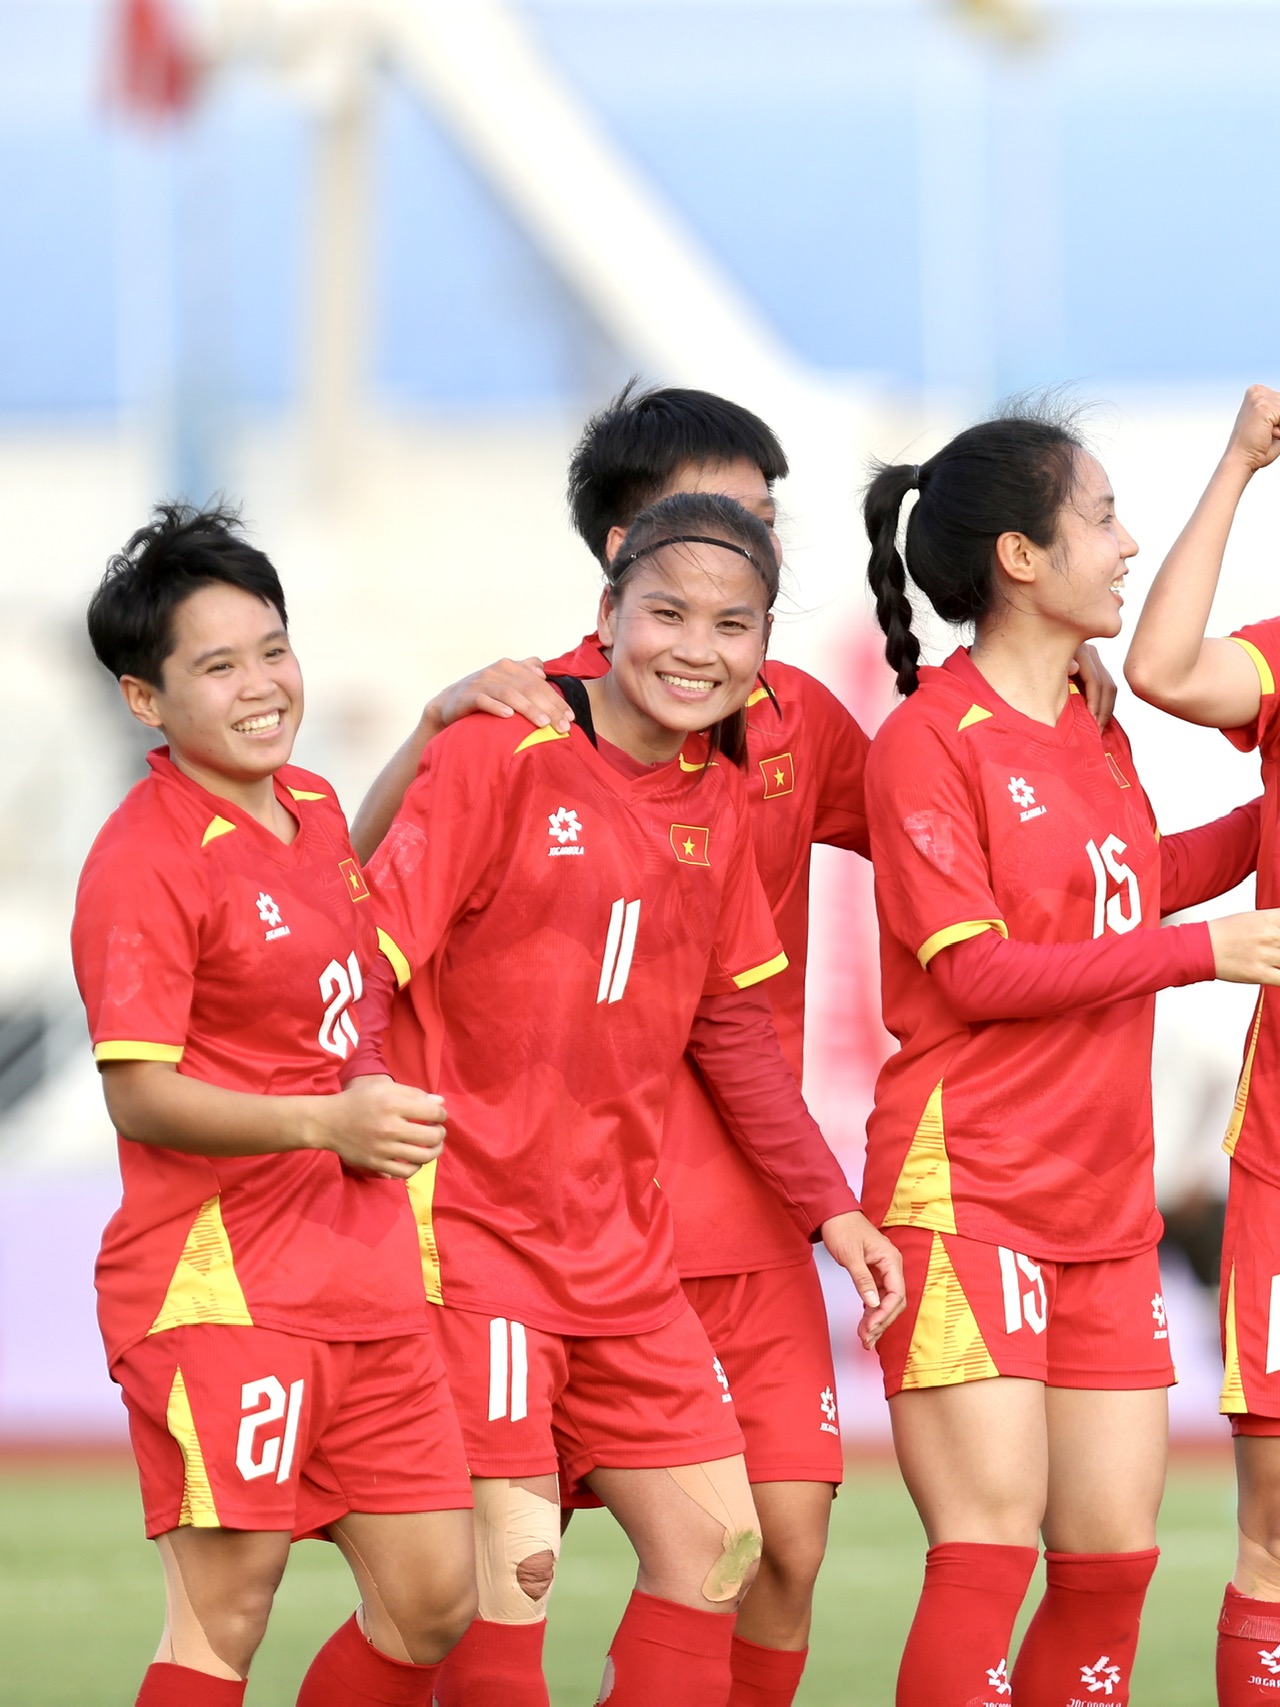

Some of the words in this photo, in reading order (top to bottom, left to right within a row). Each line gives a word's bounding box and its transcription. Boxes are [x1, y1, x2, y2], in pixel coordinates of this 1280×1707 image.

[1085, 833, 1142, 940] 15
[596, 897, 641, 1004] 11
[318, 950, 363, 1060] 21
[997, 1245, 1048, 1335] 15
[488, 1317, 528, 1423] 11
[235, 1375, 304, 1484] 21
